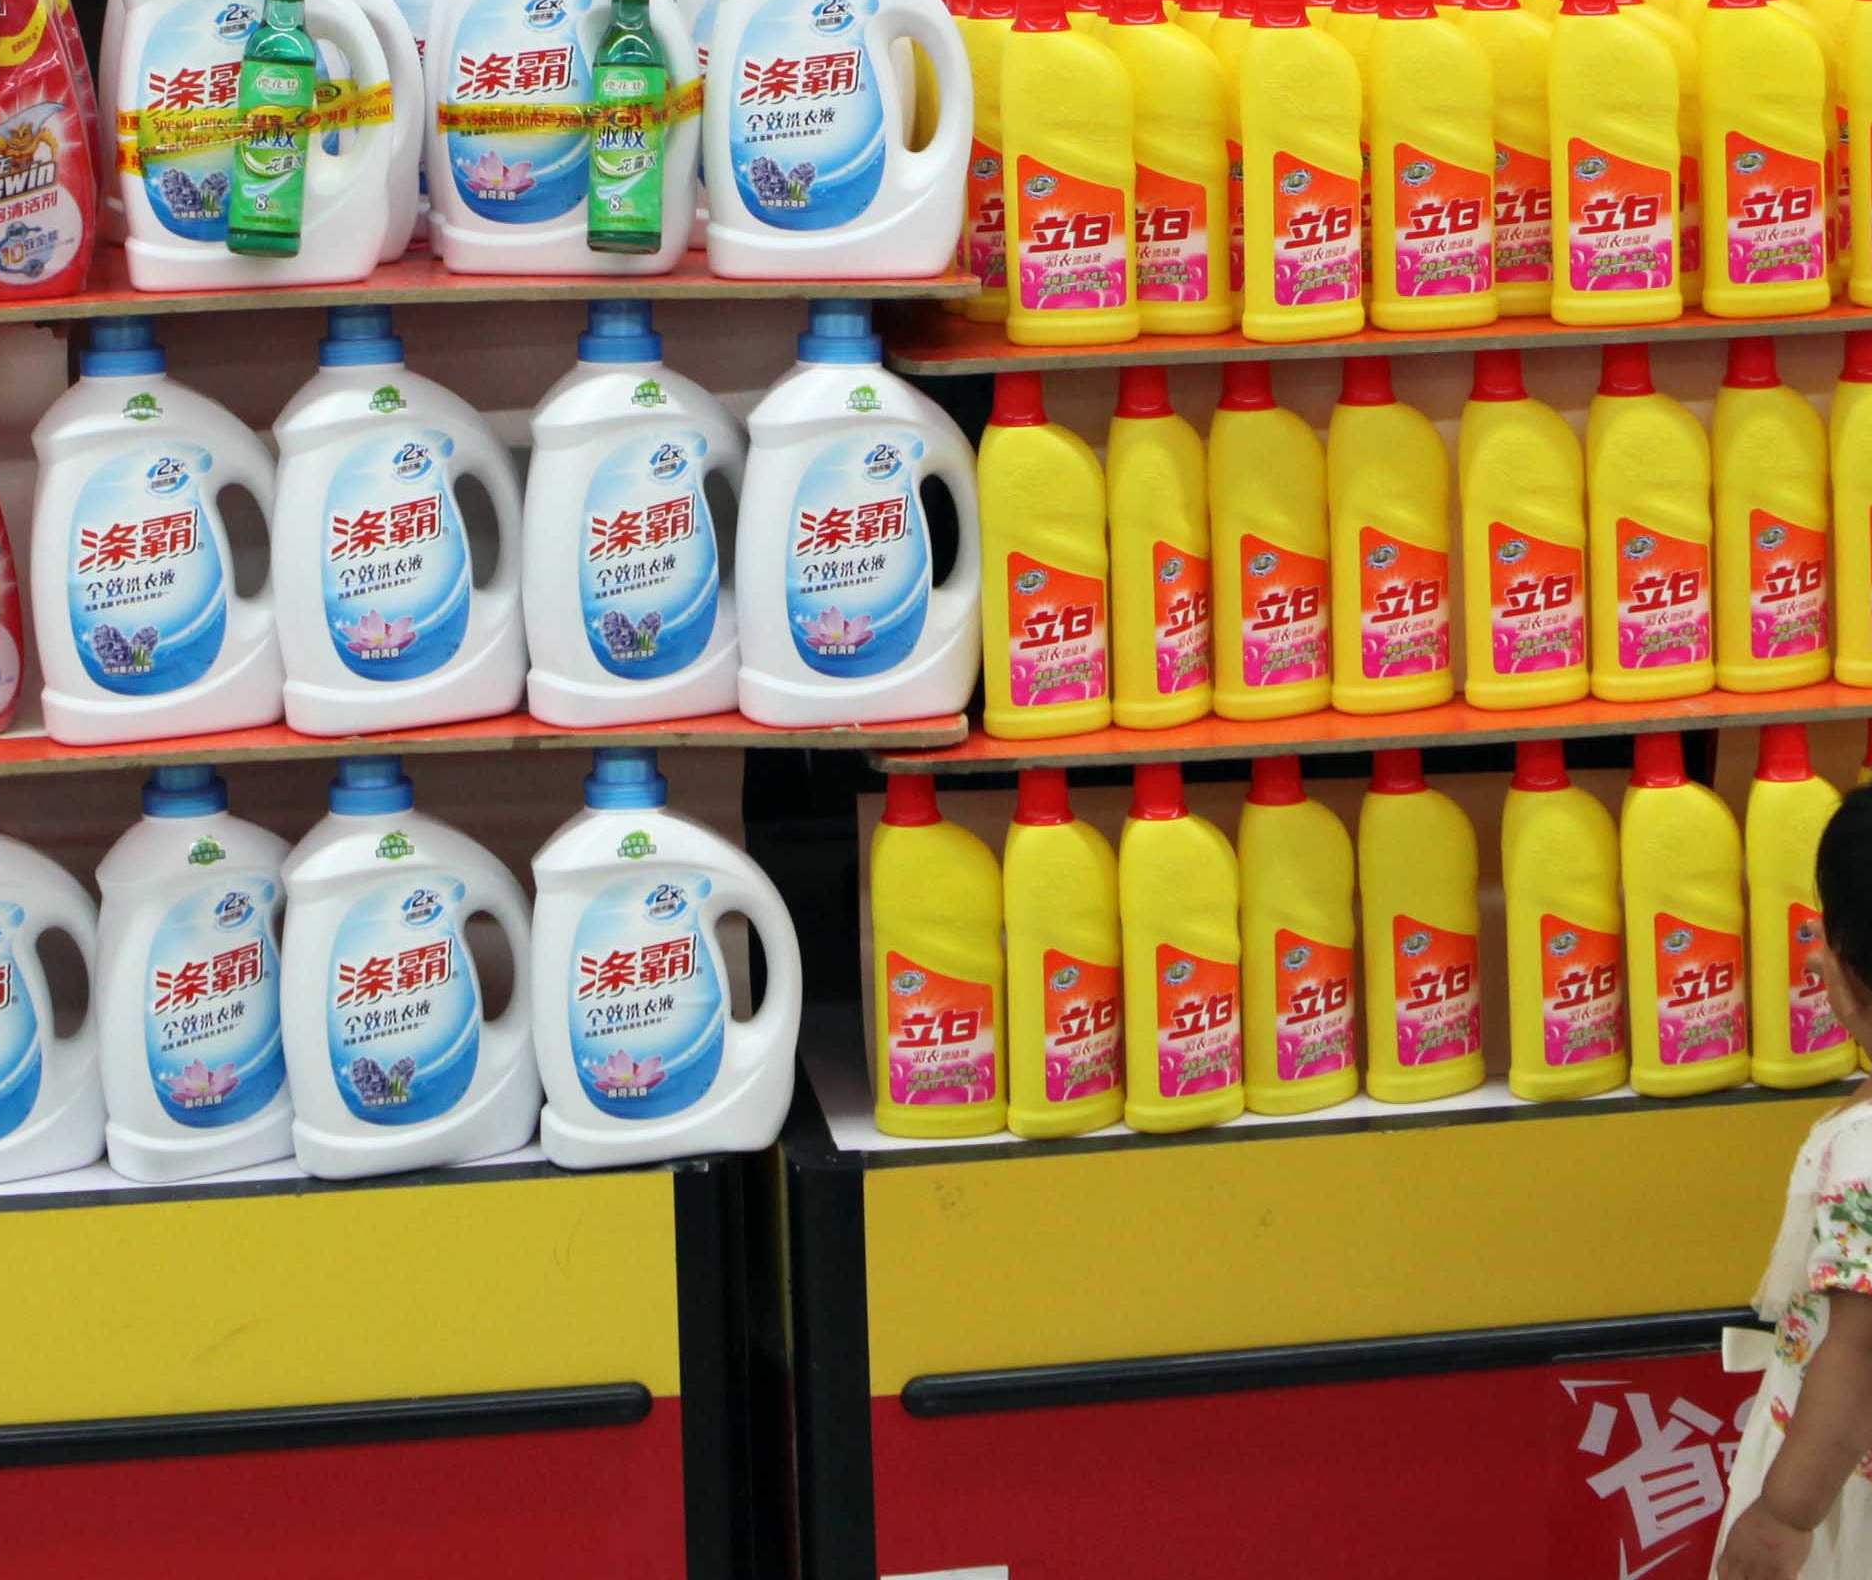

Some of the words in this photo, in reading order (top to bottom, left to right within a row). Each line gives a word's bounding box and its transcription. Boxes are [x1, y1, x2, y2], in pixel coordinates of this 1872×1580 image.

[458, 47, 571, 92] 涤霸
[740, 51, 858, 100] 涤霸
[1579, 195, 1659, 234] 立白
[1738, 188, 1813, 228] 立白
[1029, 213, 1111, 253] 立白
[81, 511, 198, 562] 涤霸
[332, 496, 439, 556] 涤霸
[590, 505, 694, 554] 涤霸
[799, 498, 908, 552] 涤霸
[1629, 571, 1700, 613] 立白
[1020, 606, 1094, 649] 立白
[155, 947, 264, 1006] 涤霸
[338, 944, 453, 1002] 涤霸
[580, 938, 690, 994] 涤霸
[898, 1010, 979, 1047] 立白
